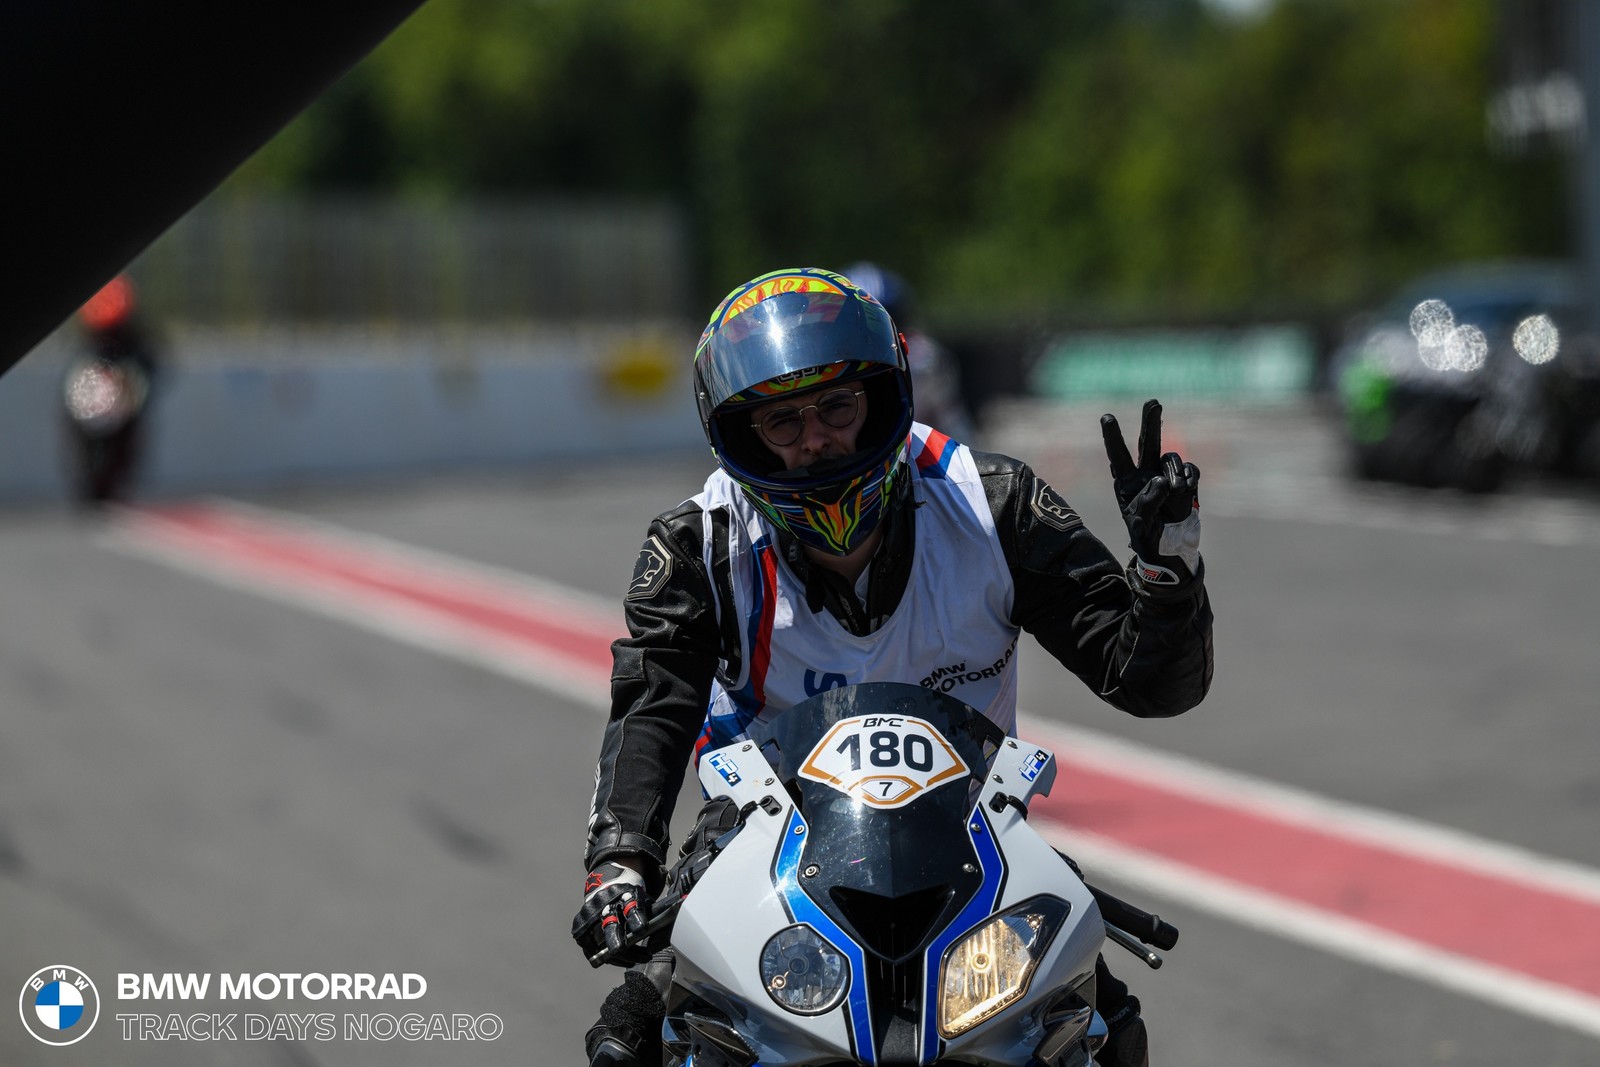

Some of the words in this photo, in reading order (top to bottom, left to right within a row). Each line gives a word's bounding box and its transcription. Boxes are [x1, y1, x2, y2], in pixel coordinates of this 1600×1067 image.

[920, 662, 966, 689] BMW
[863, 717, 904, 728] BMC
[836, 730, 934, 773] 180
[1018, 749, 1049, 782] HP4
[708, 752, 742, 787] HP4
[879, 781, 893, 797] 7
